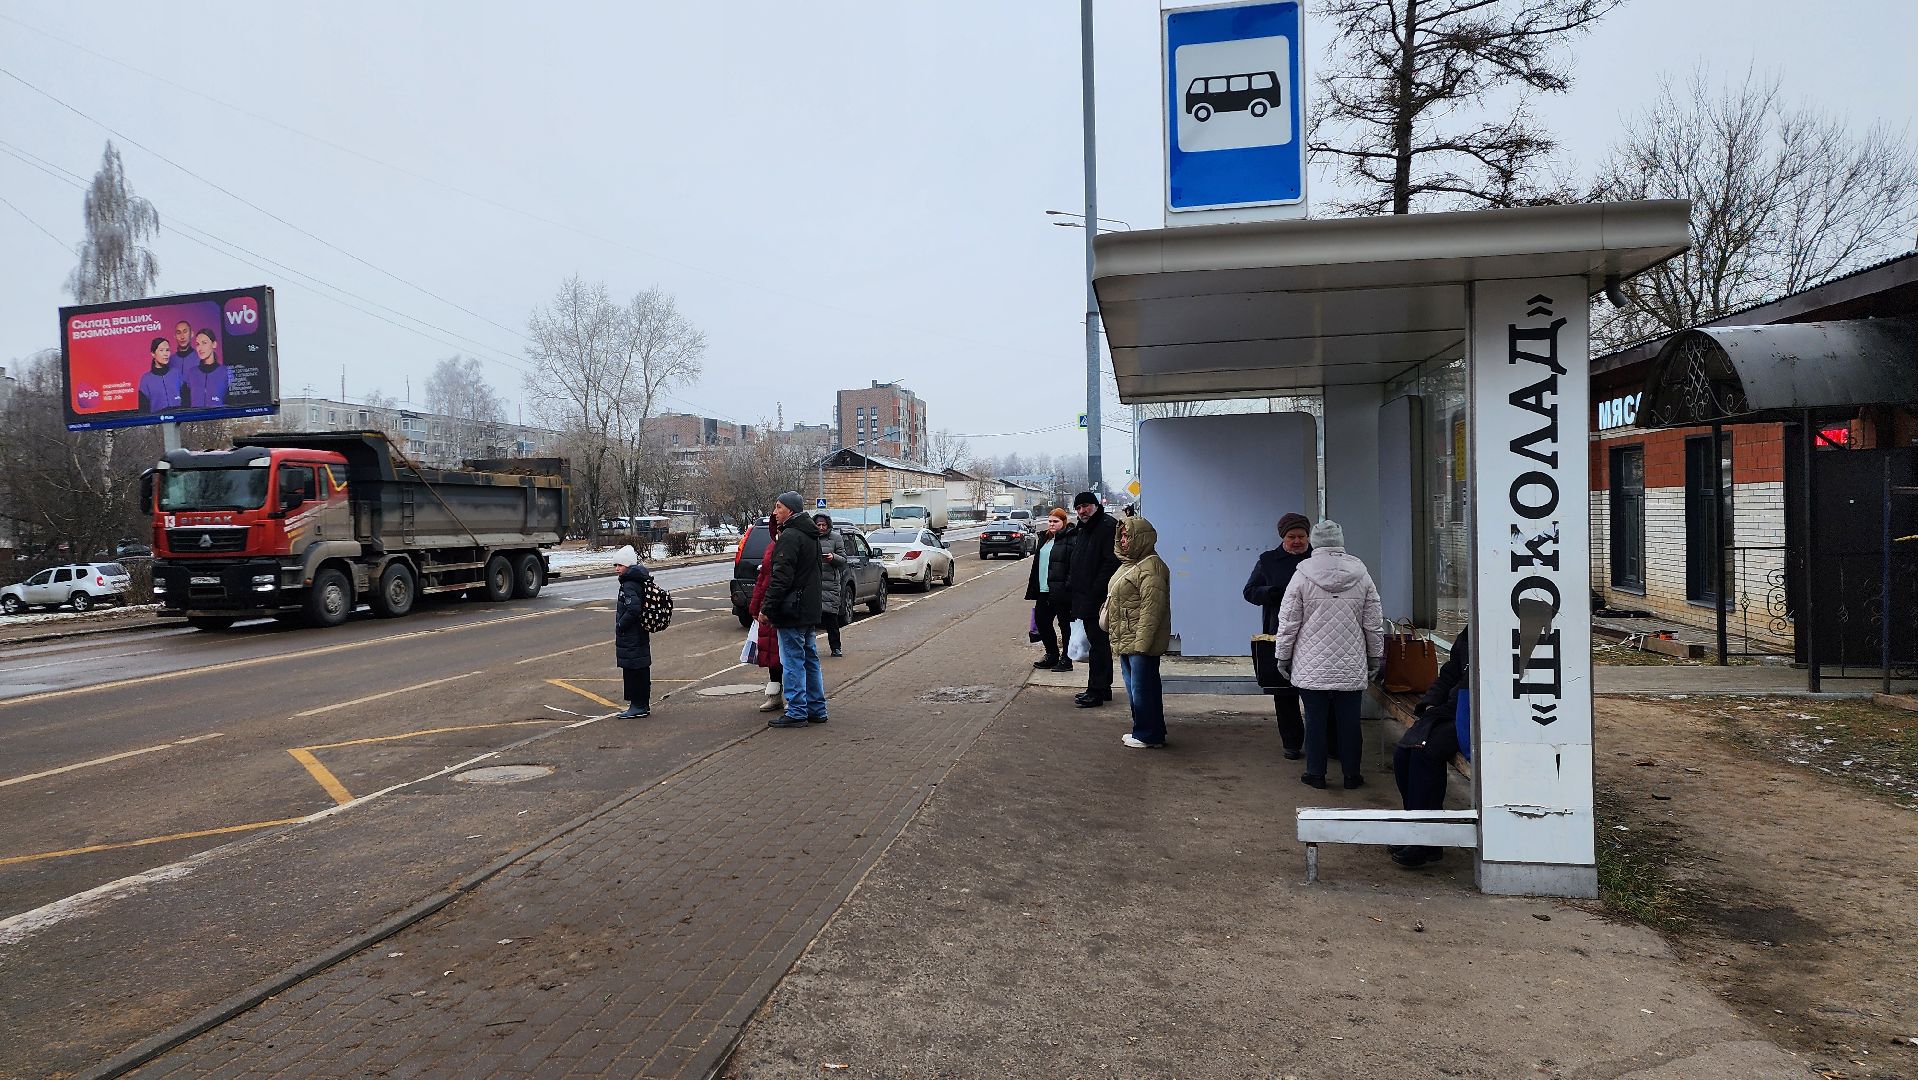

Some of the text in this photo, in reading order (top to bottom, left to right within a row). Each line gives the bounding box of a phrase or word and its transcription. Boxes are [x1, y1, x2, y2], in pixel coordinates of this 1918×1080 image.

[72, 314, 153, 330] Склад ваших
[226, 305, 257, 325] wb
[72, 321, 162, 340] возможностей
[247, 344, 259, 352] 18+
[1508, 293, 1567, 726] «ШОКОЛАД»
